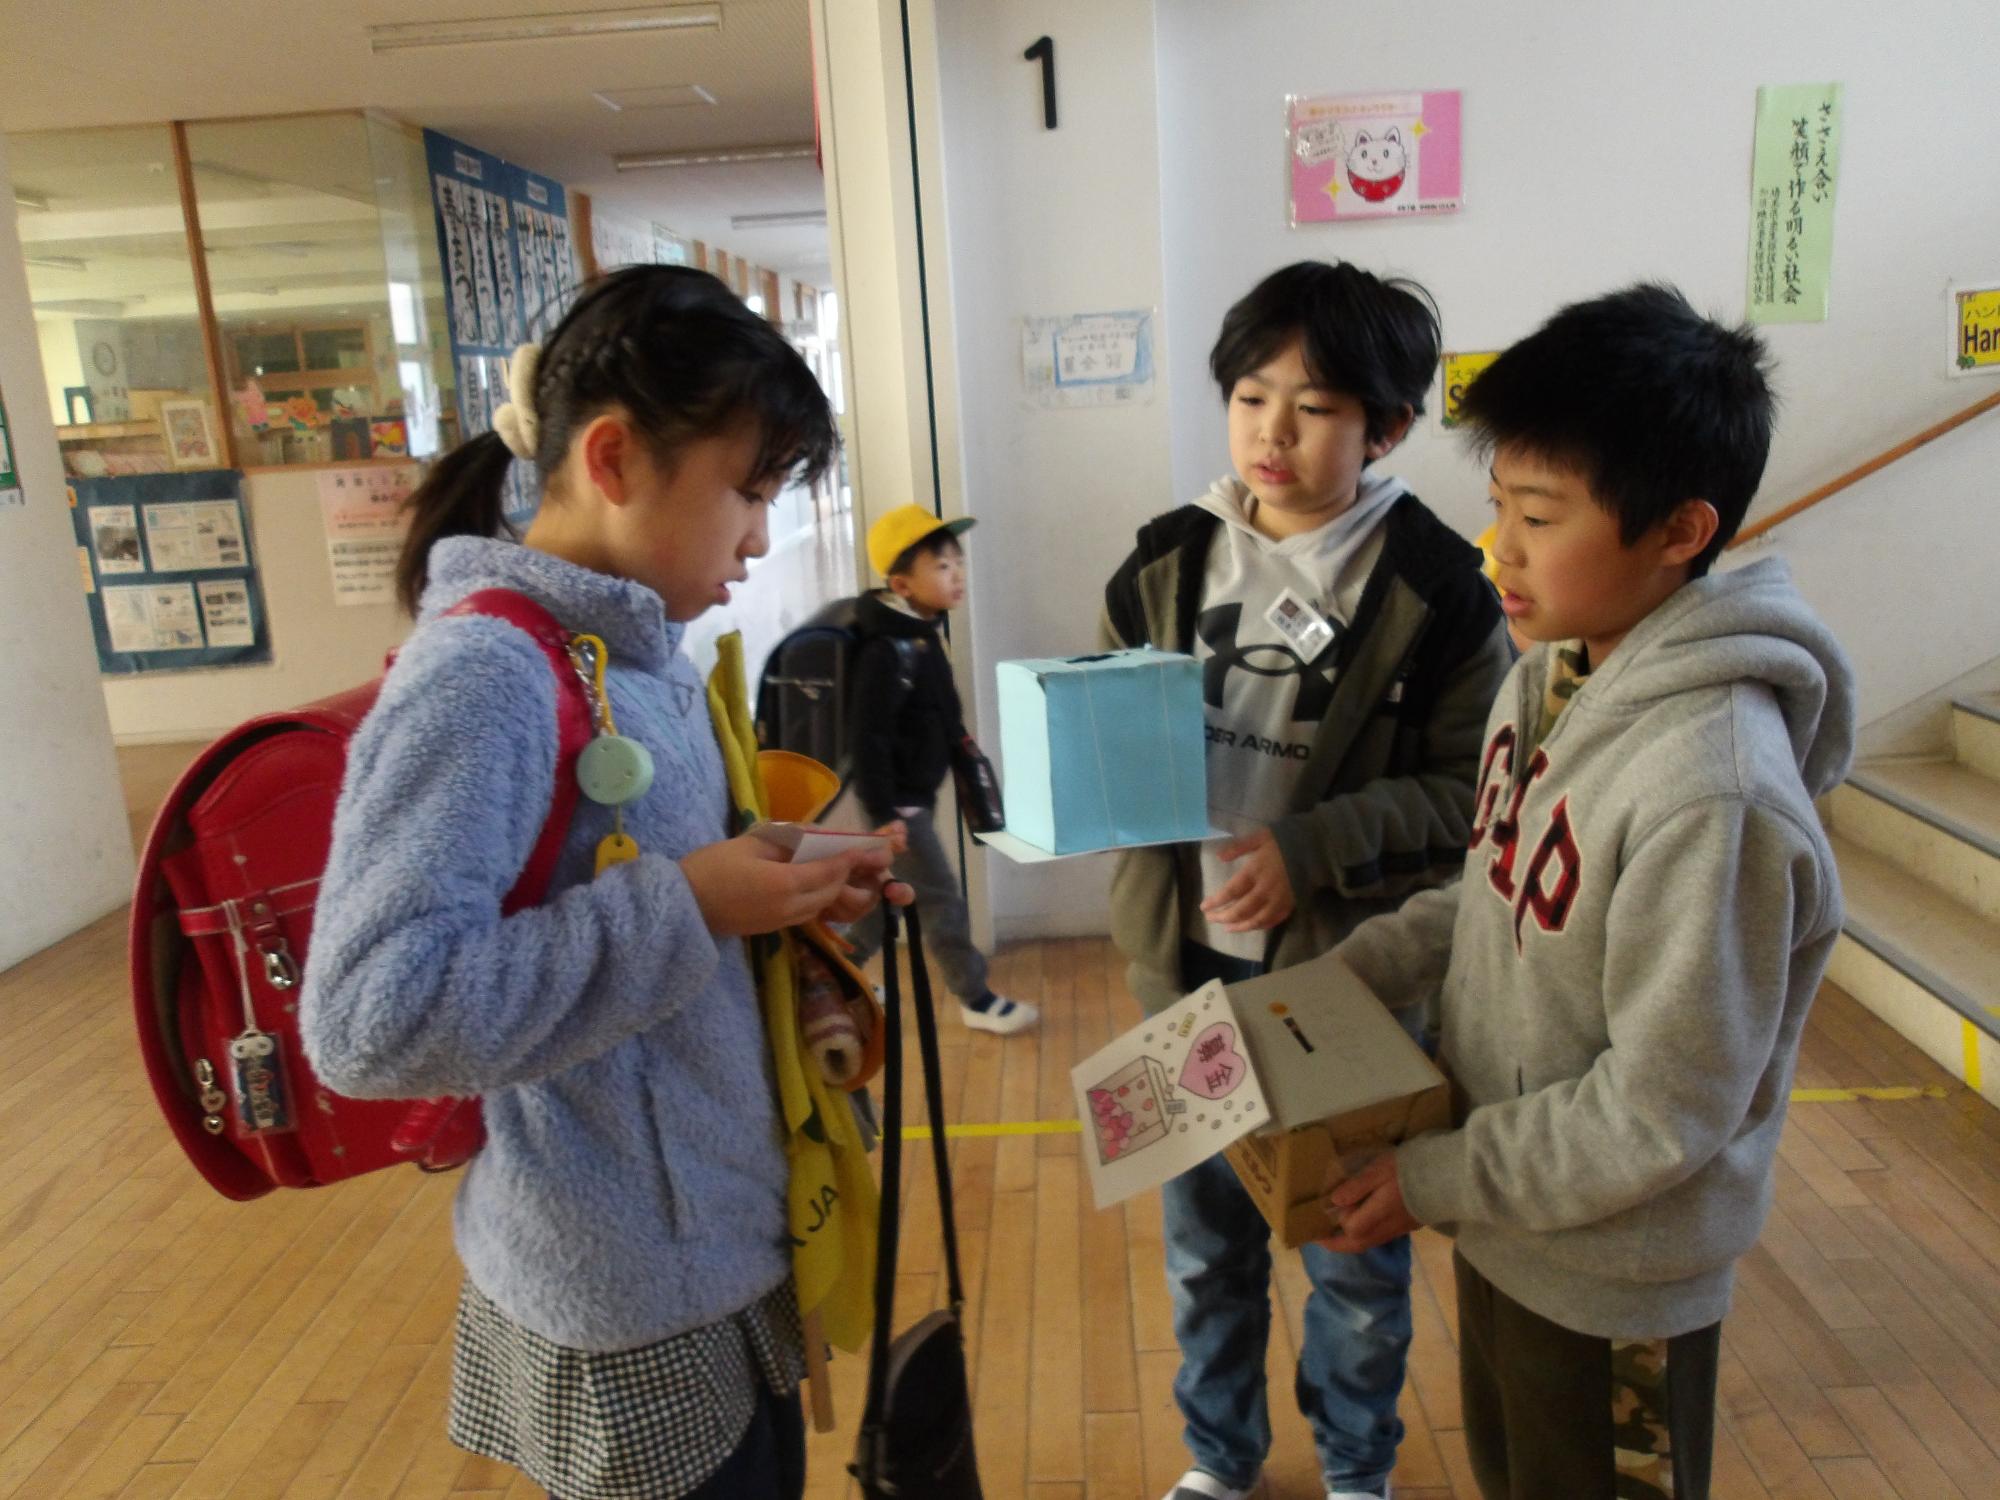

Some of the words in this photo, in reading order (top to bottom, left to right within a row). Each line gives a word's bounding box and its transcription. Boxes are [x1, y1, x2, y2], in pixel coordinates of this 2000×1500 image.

[1024, 35, 1057, 129] 1
[1812, 100, 1833, 204] ささえ合い
